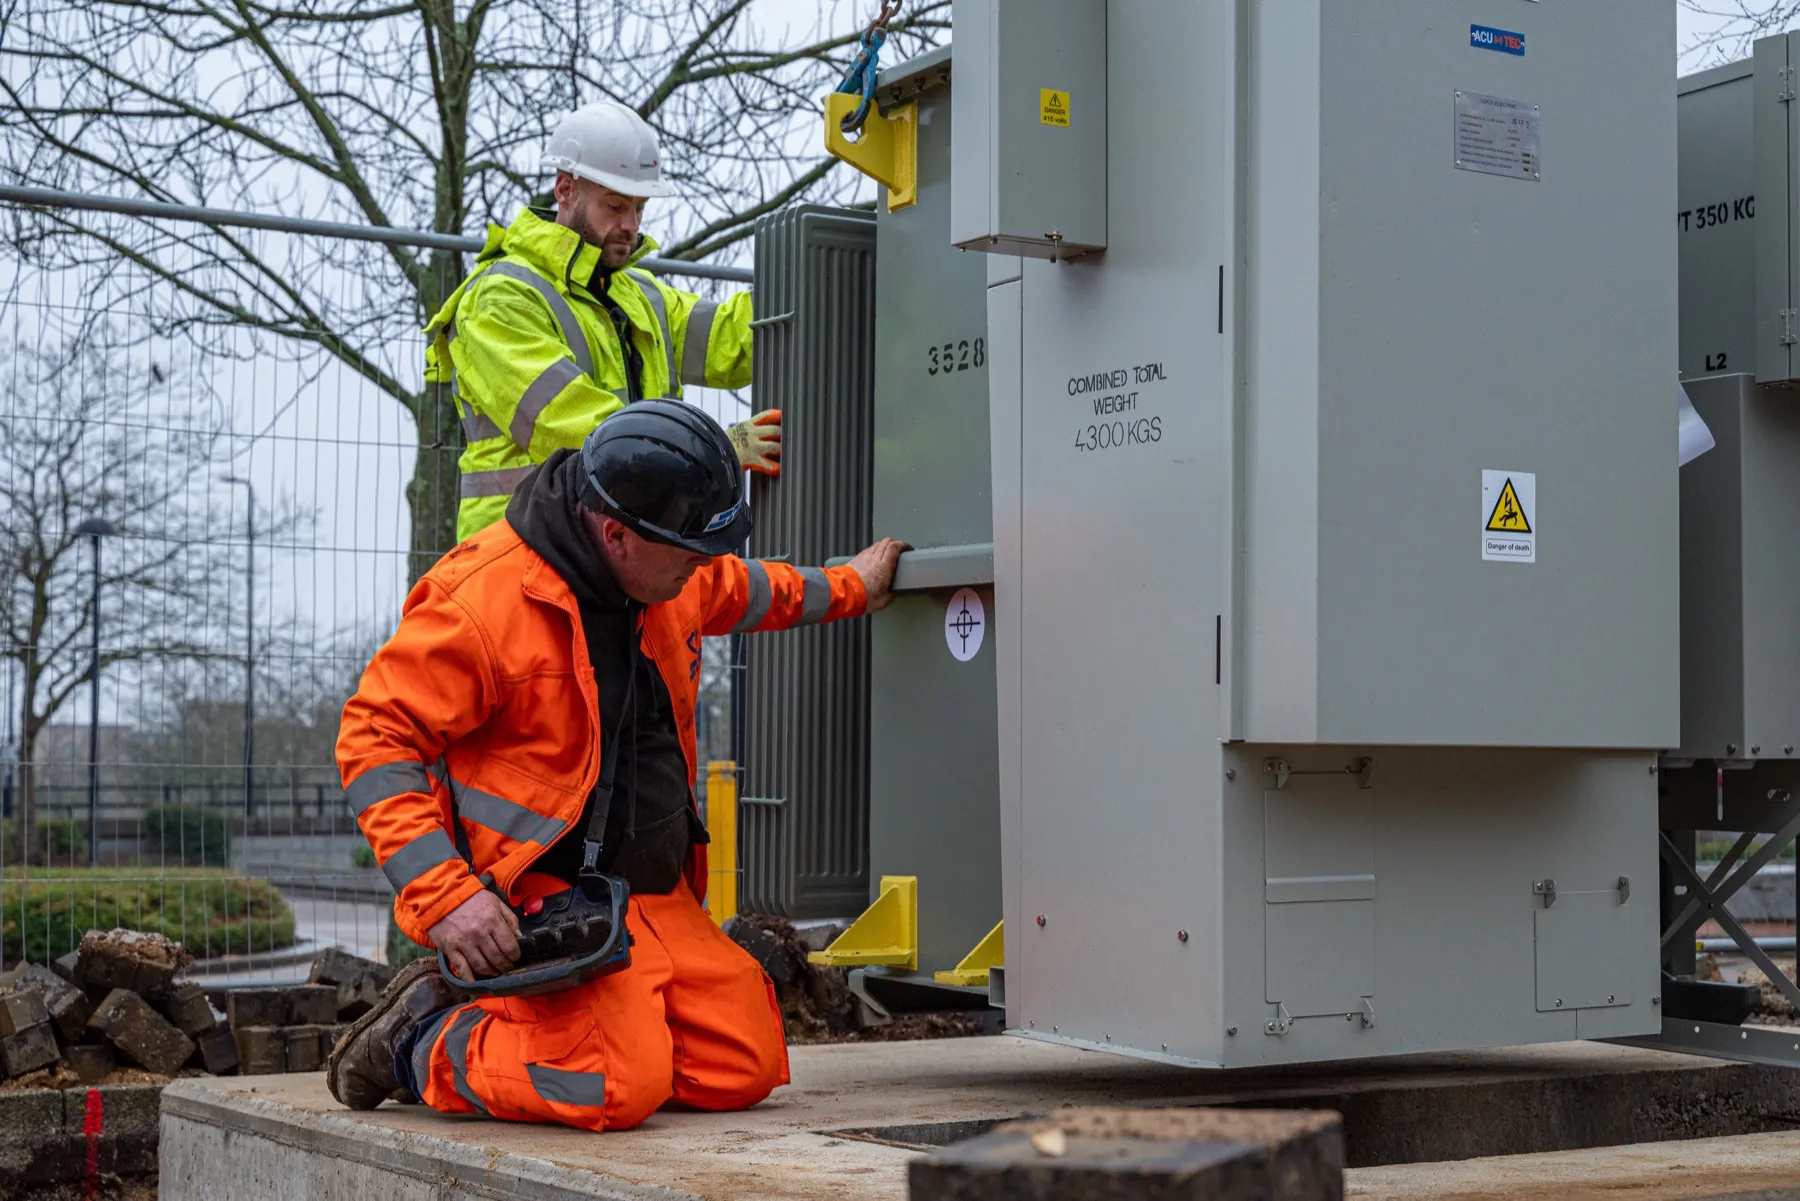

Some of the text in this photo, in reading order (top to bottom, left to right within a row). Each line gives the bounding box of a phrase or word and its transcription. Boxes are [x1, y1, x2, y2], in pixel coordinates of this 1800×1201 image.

[1474, 30, 1521, 50] ACU TEC
[1044, 107, 1066, 116] DANGER
[1678, 210, 1691, 232] T
[1696, 202, 1728, 229] 350
[928, 337, 984, 376] 3528
[1706, 352, 1727, 372] L2
[1068, 362, 1167, 396] COMBINED TOTAL
[1094, 392, 1139, 416] WEIGHT
[1075, 416, 1162, 452] 4300 KGS
[1487, 542, 1507, 551] Danger
